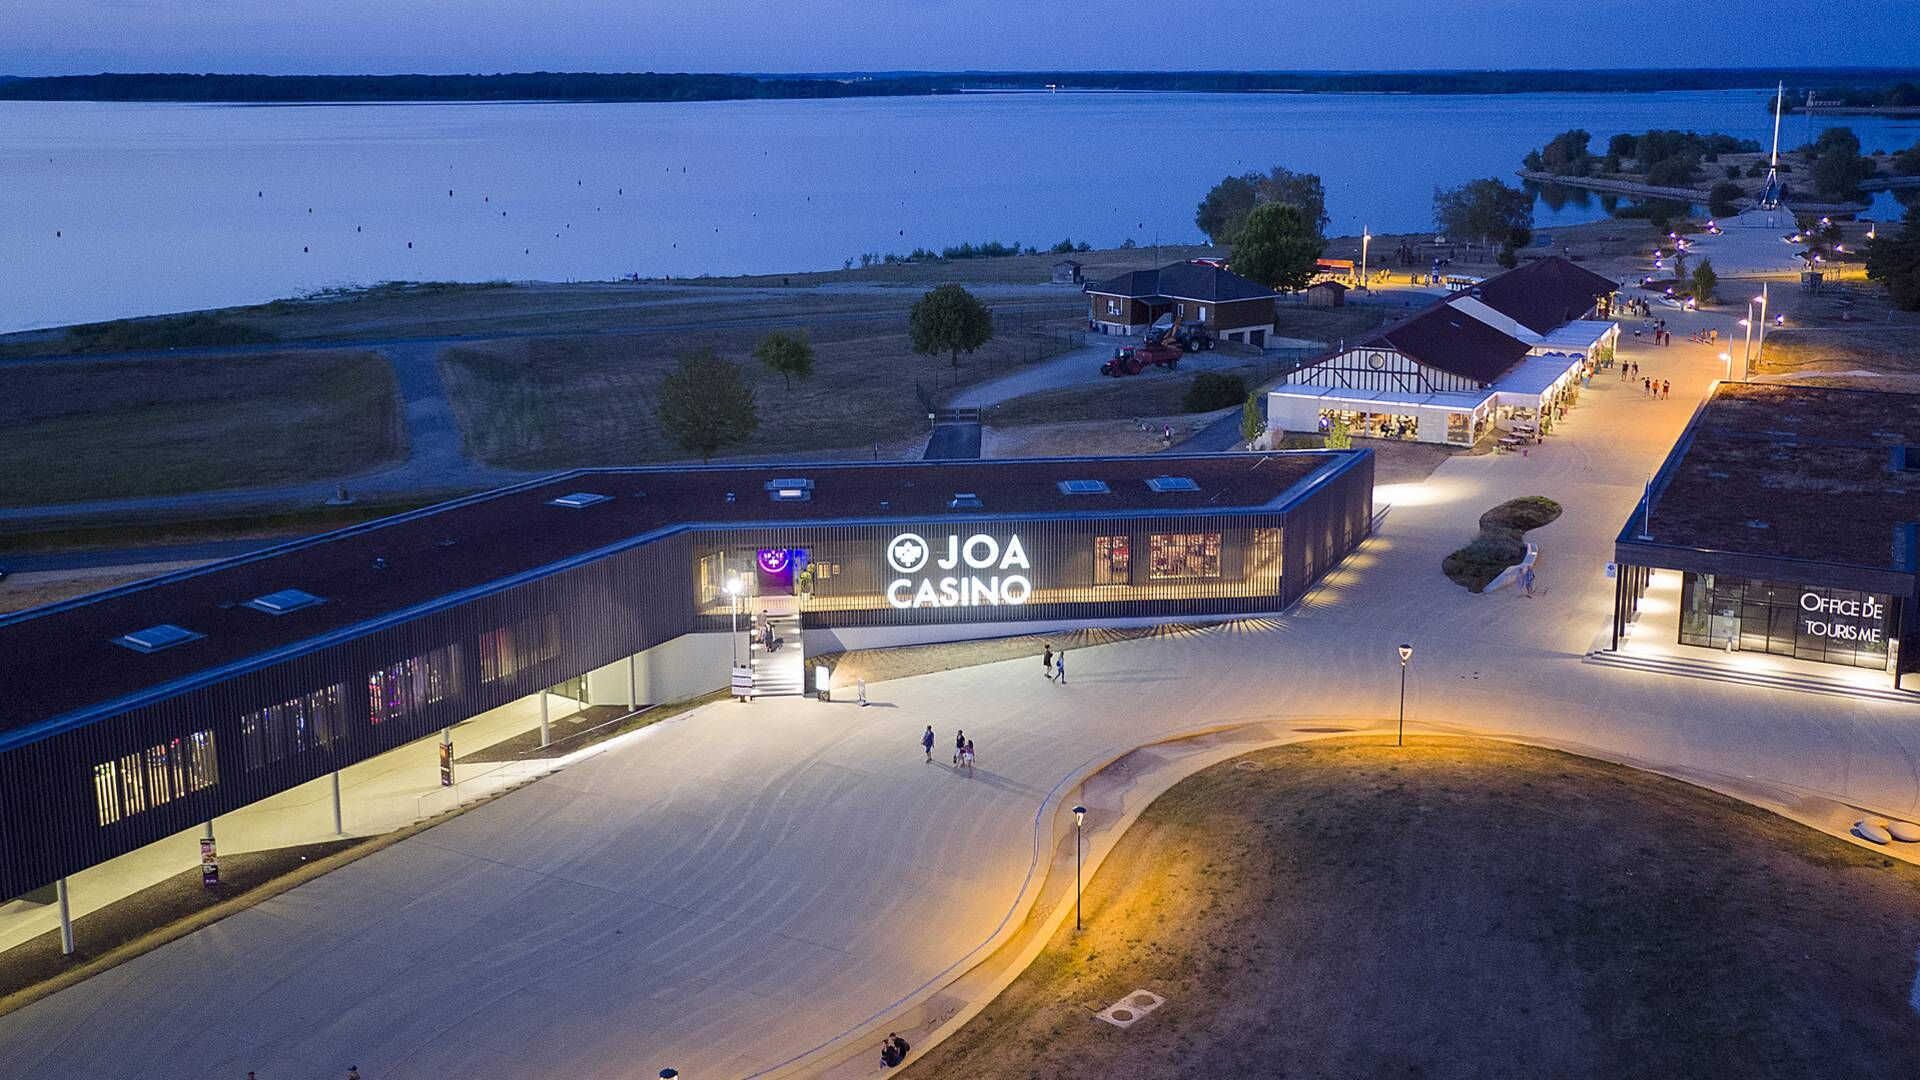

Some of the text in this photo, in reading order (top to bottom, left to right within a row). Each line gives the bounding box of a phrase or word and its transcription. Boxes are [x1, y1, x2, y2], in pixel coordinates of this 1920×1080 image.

[938, 533, 1031, 570] JOA
[887, 574, 1032, 608] CASINO
[1800, 592, 1883, 619] OFFICE DE
[1805, 620, 1881, 643] TOURISME
